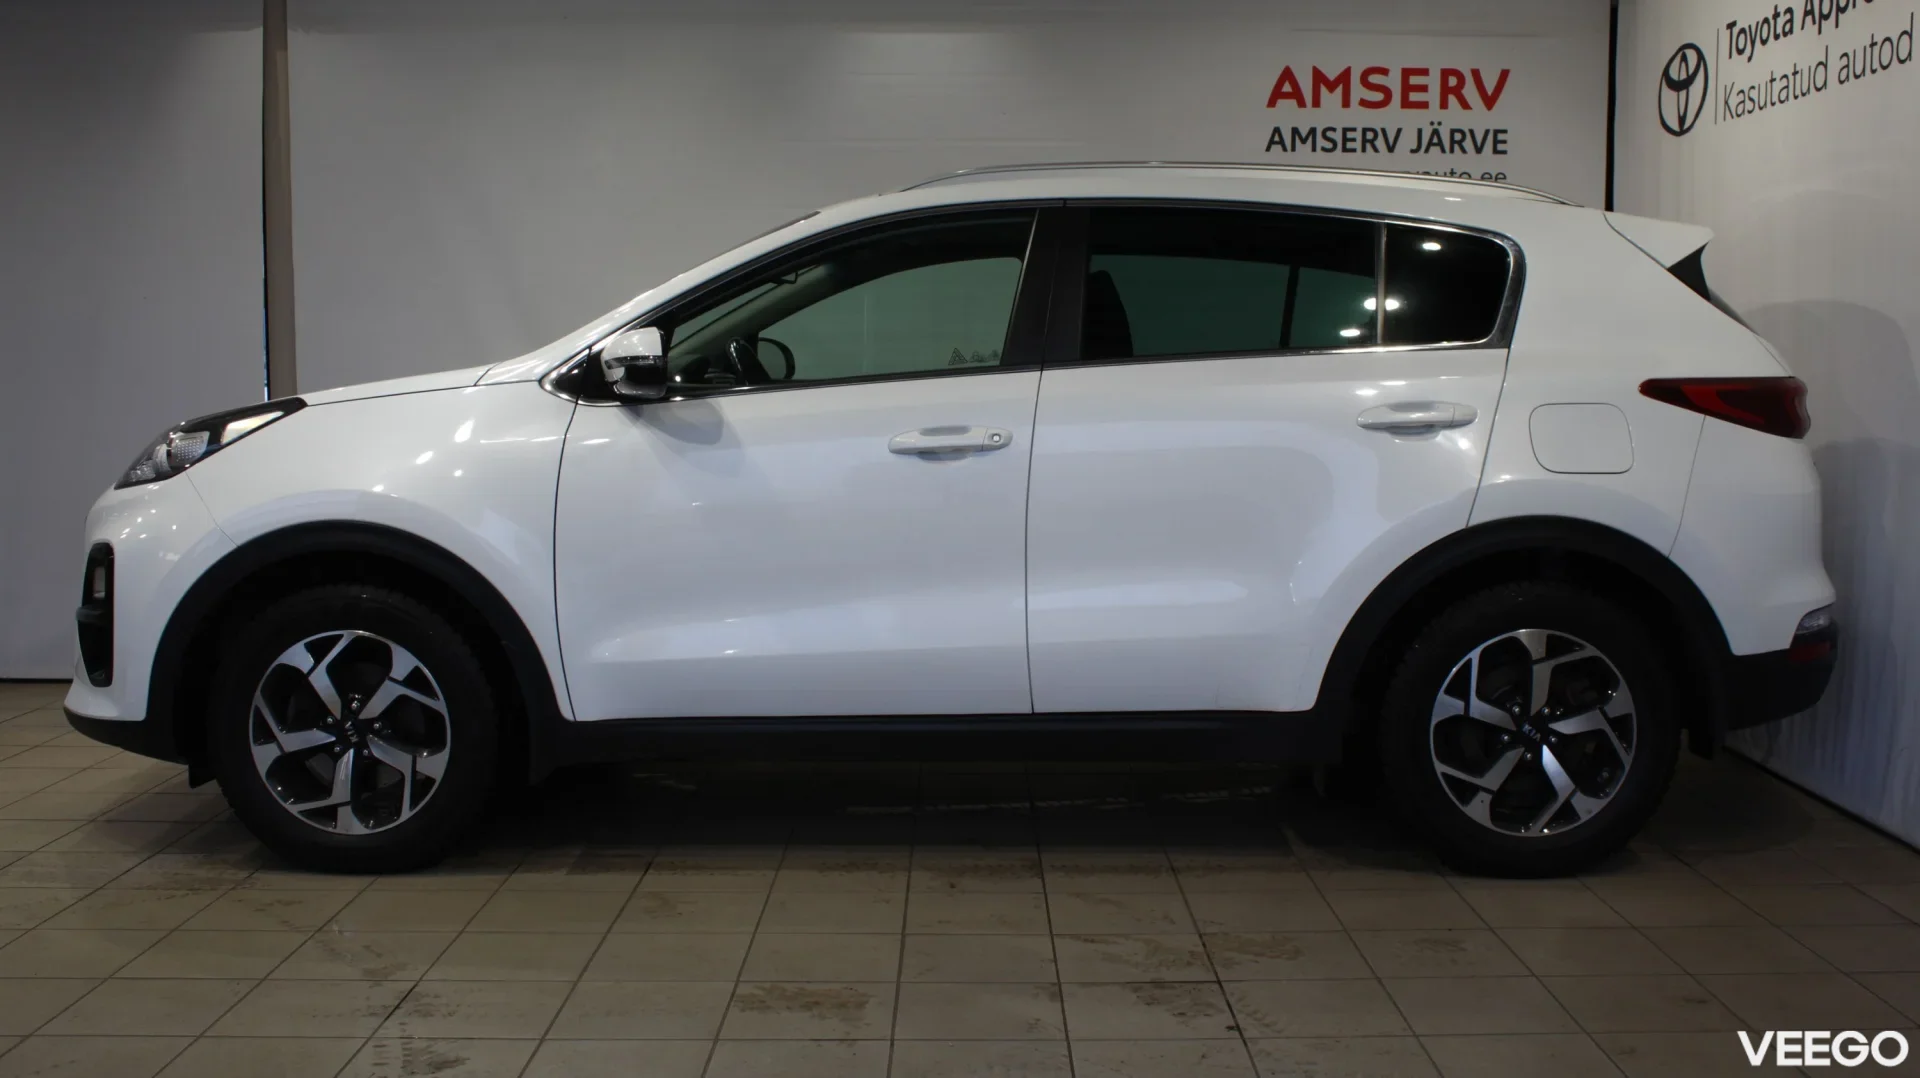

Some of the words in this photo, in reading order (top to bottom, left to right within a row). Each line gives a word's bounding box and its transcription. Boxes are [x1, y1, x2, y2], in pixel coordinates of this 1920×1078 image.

[1726, 4, 1794, 63] Toyota
[1800, 0, 1874, 35] App
[1266, 65, 1511, 111] AMSERV
[1722, 45, 1829, 122] Kasutatud
[1837, 12, 1915, 85] autod
[1265, 126, 1402, 153] AMSERV
[1409, 121, 1508, 155] JÄRVE
